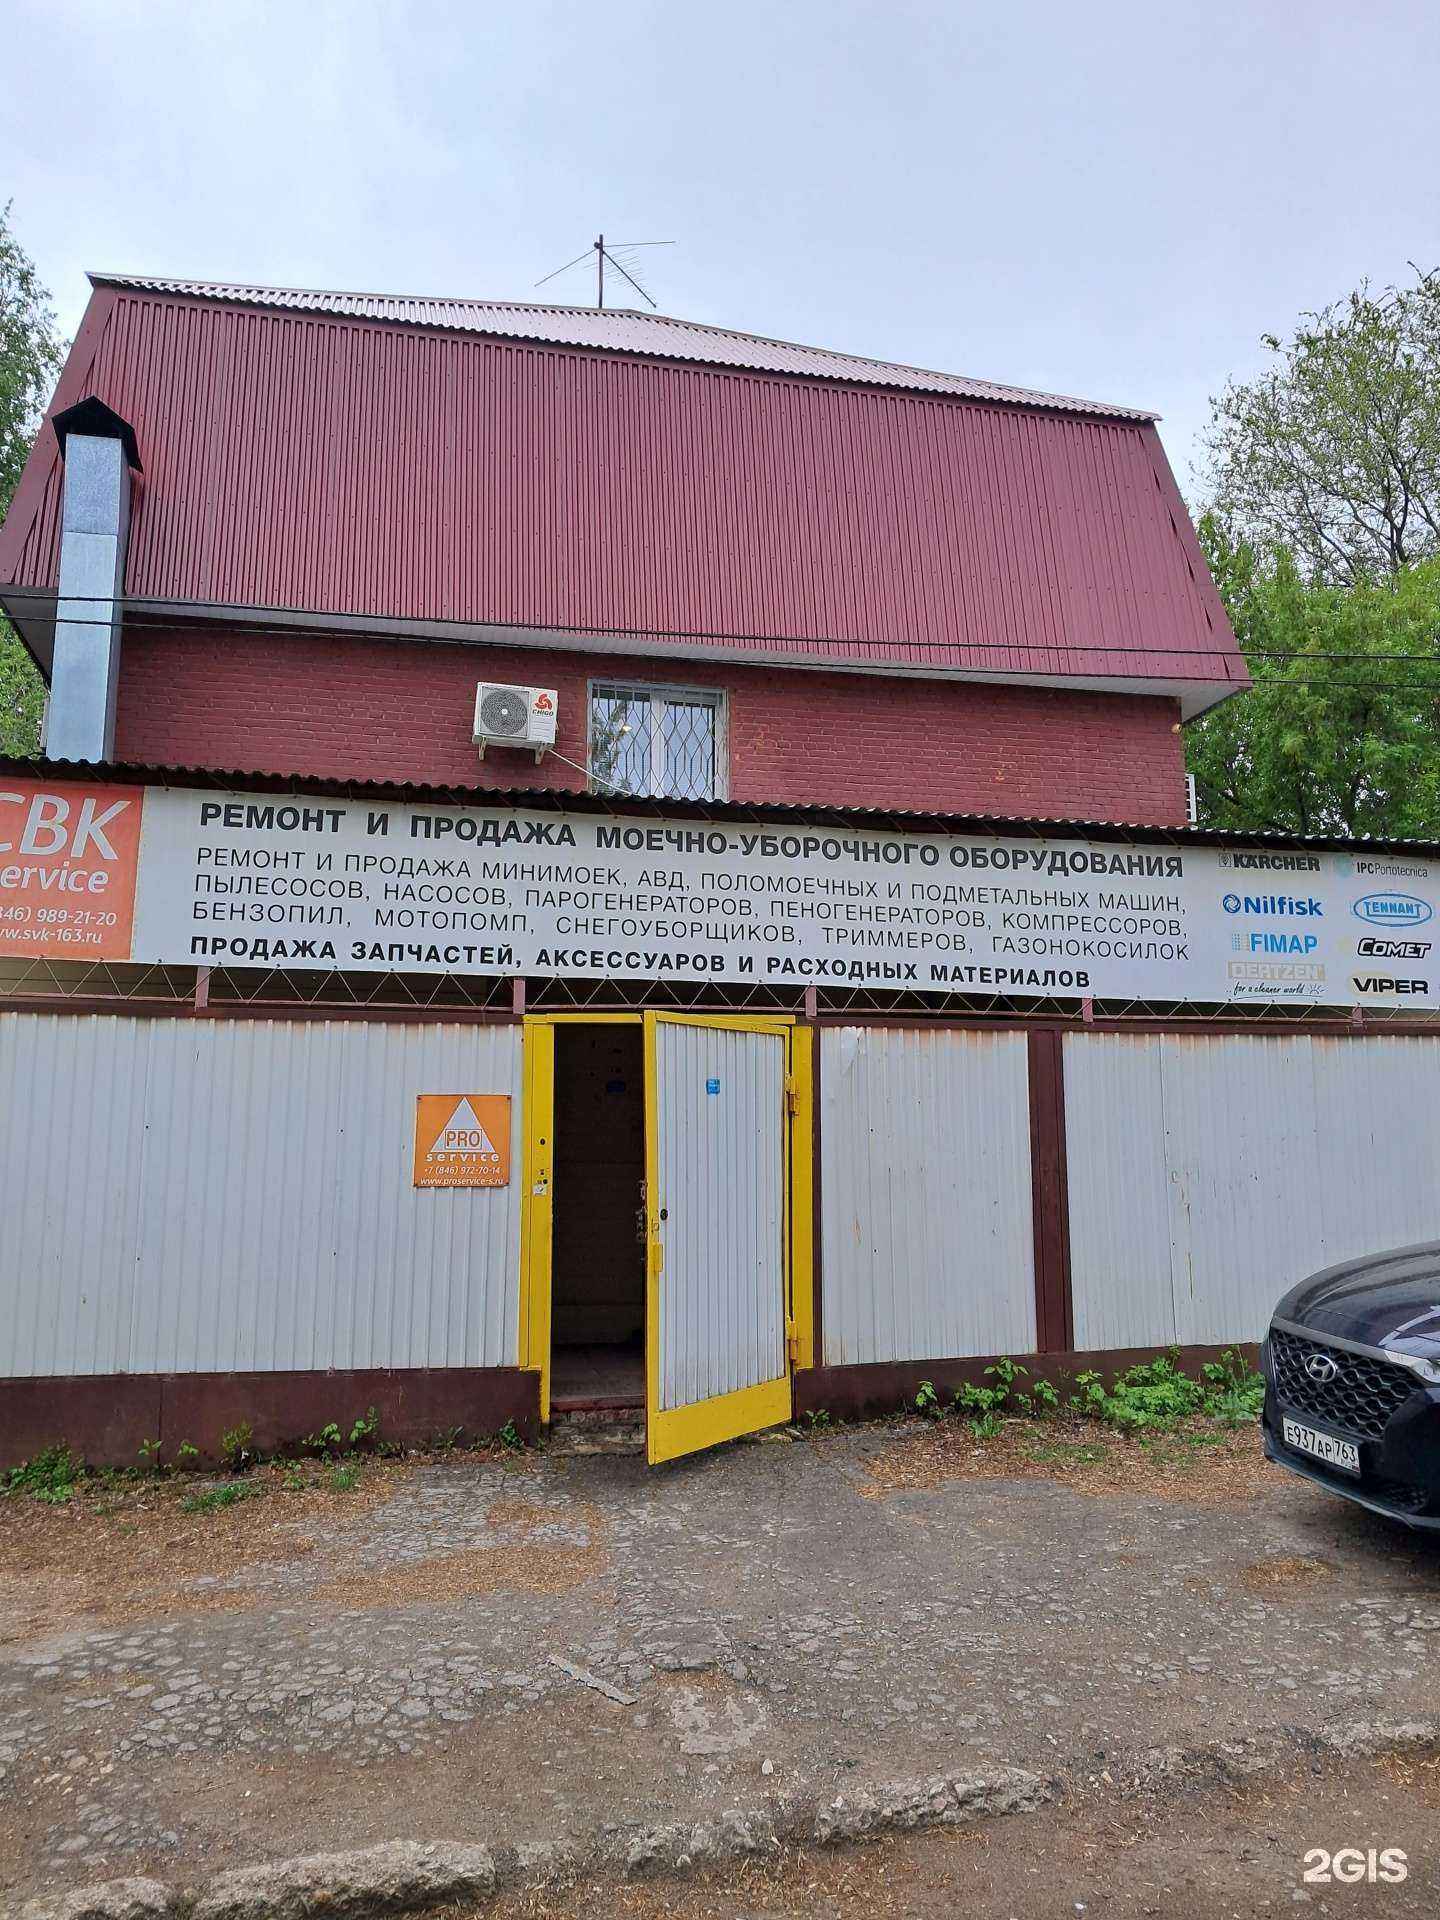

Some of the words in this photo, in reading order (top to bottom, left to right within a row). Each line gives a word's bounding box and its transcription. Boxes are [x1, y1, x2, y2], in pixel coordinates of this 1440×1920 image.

[200, 802, 346, 833] РЕМОНТ
[367, 812, 389, 836] И
[410, 815, 577, 848] ПРОДАЖА
[596, 826, 940, 867] МОЕЧНО-УБОРОЧНОГО
[949, 846, 1183, 877] ОБОРУДОВАНИЯ
[0, 861, 109, 893] ervice
[197, 847, 305, 869] РЕМОНТ
[317, 853, 332, 871] И
[345, 854, 471, 879] ПРОДАЖА
[482, 862, 627, 887] МИНИМОЕК,
[637, 870, 690, 891] АВД,
[701, 872, 878, 898] ПОЛОМОЕЧНЫХ
[888, 883, 901, 898] И
[912, 884, 1090, 908] ПОДМЕТАЛЬНЫХ
[1099, 893, 1186, 914] МАШИН,
[195, 874, 370, 902] ПЫЛЕСОСОВ,
[384, 883, 512, 907] НАСОСОВ,
[525, 889, 758, 917] ПАРОГЕНЕРАТОРОВ,
[770, 900, 992, 929] ПЕНОГЕНЕРАТОРОВ,
[1003, 912, 1187, 938] КОМПРЕССОРОВ,
[1244, 896, 1323, 916] Nilfisk
[1363, 901, 1421, 918] TENNANT
[37, 909, 116, 926] 989-21-20
[192, 901, 351, 927] БЕНЗОПИЛ,
[375, 908, 534, 934] МОТОПОМП,
[556, 916, 802, 945] СНЕГОУБОРЩИКОВ,
[822, 927, 973, 953] ТРИММЕРОВ,
[992, 936, 1189, 960] ГАЗОНОКОСИЛОК
[1250, 933, 1318, 953] FIMAP
[1357, 938, 1431, 958] COMET
[190, 936, 336, 960] ПРОДАЖА
[351, 941, 521, 968] ЗАПЧАСТЕЙ,
[535, 948, 725, 972] АКСЕССУАРОВ
[739, 955, 753, 972] И
[767, 957, 917, 981] РАСХОДНЫХ
[930, 965, 1089, 987] МАТЕРИАЛОВ
[1353, 977, 1428, 994] VIPER
[446, 1131, 480, 1147] PRO
[426, 1153, 499, 1162] service
